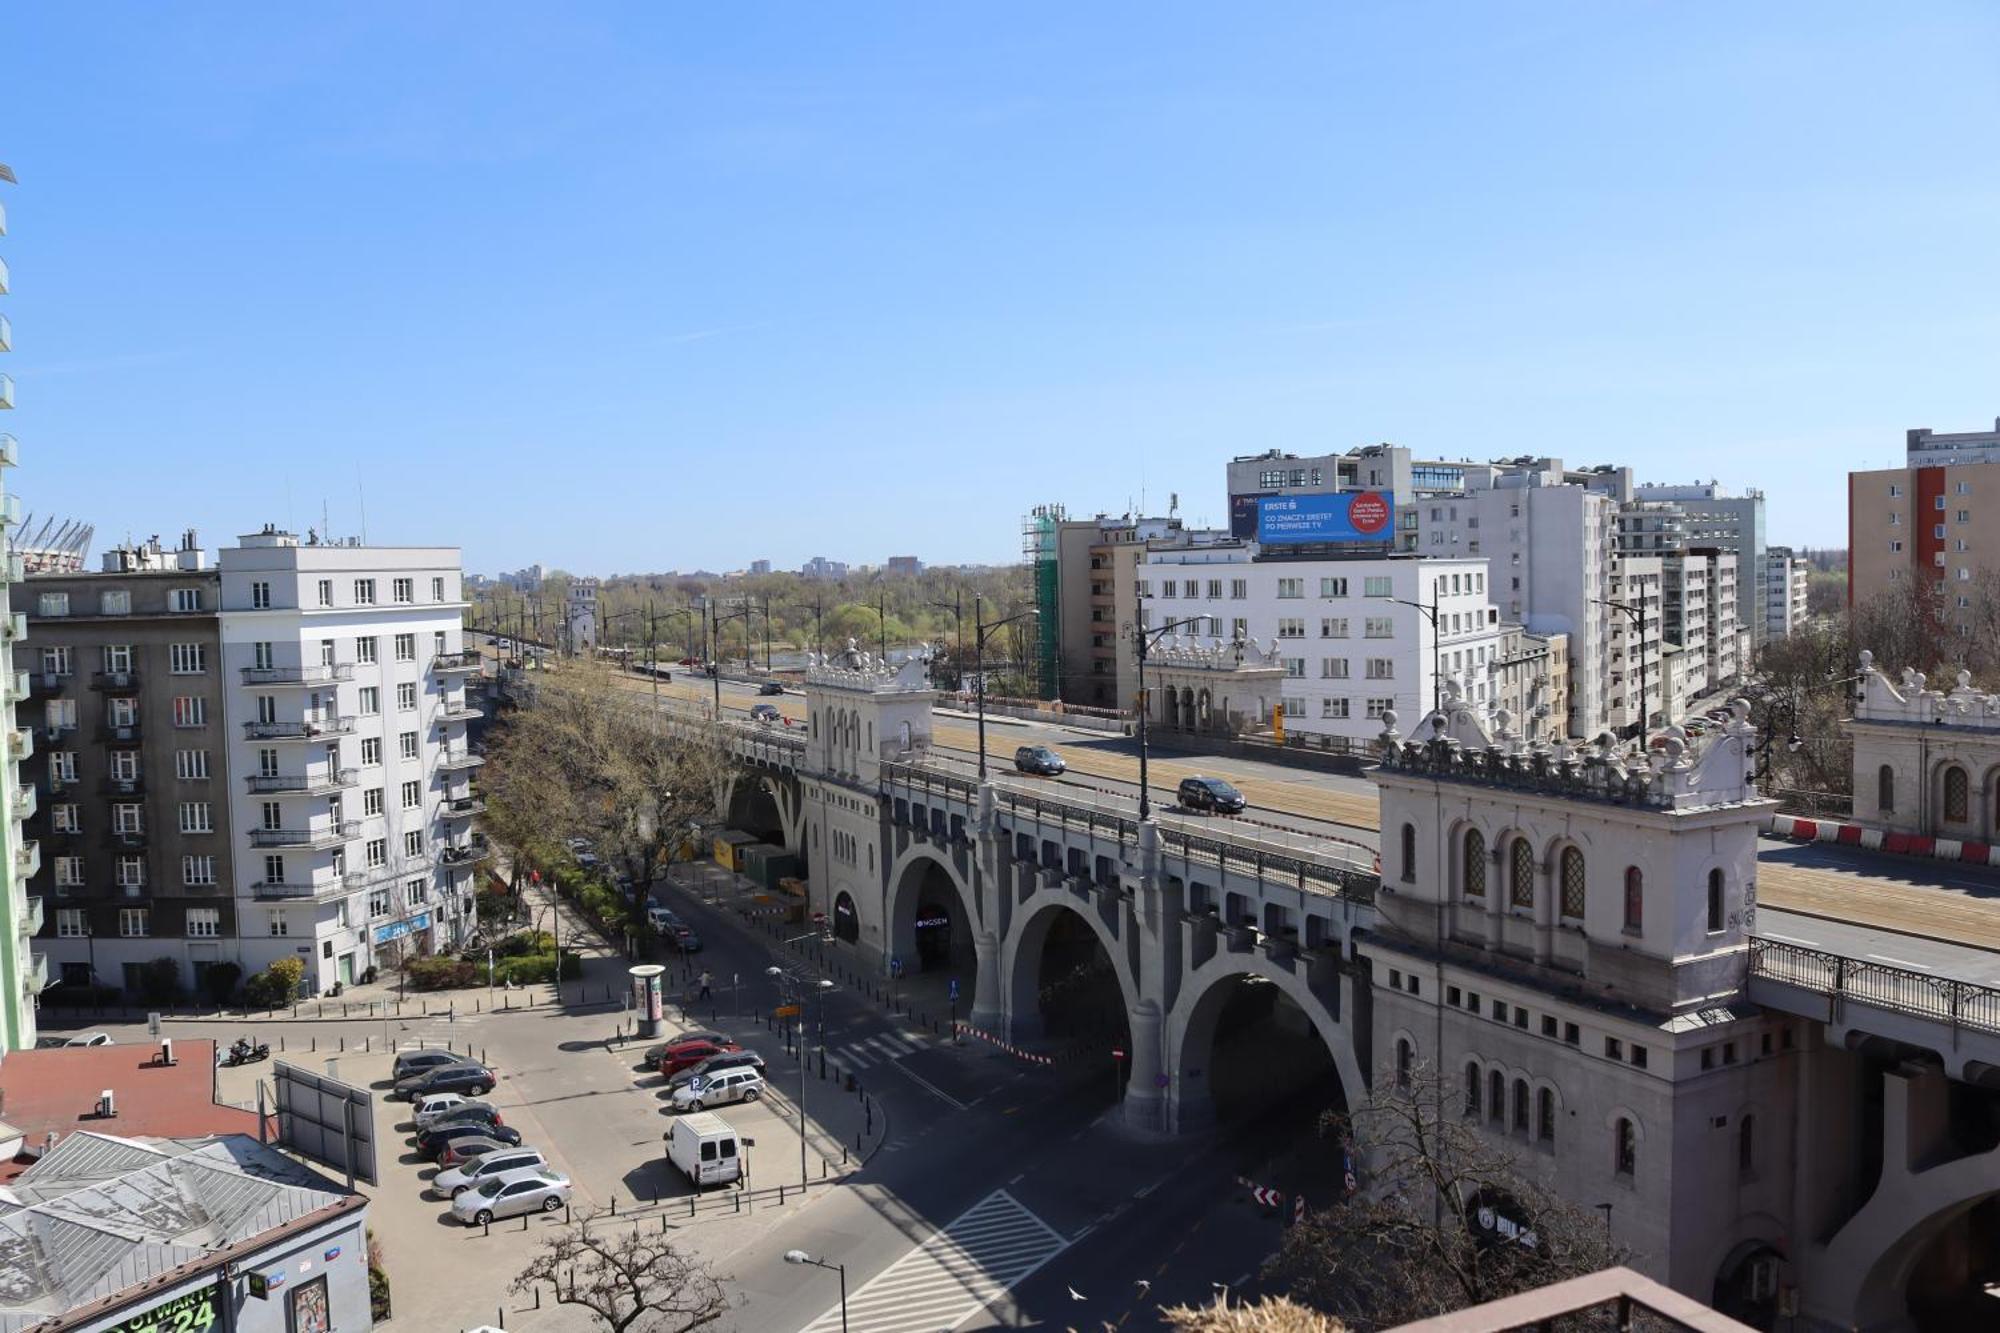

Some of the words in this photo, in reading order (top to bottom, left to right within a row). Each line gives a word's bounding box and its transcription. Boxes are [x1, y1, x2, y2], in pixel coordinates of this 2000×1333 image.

[1265, 502, 1288, 511] ERSTE
[1265, 514, 1277, 522] CO
[130, 1285, 217, 1330] OTWARTE
